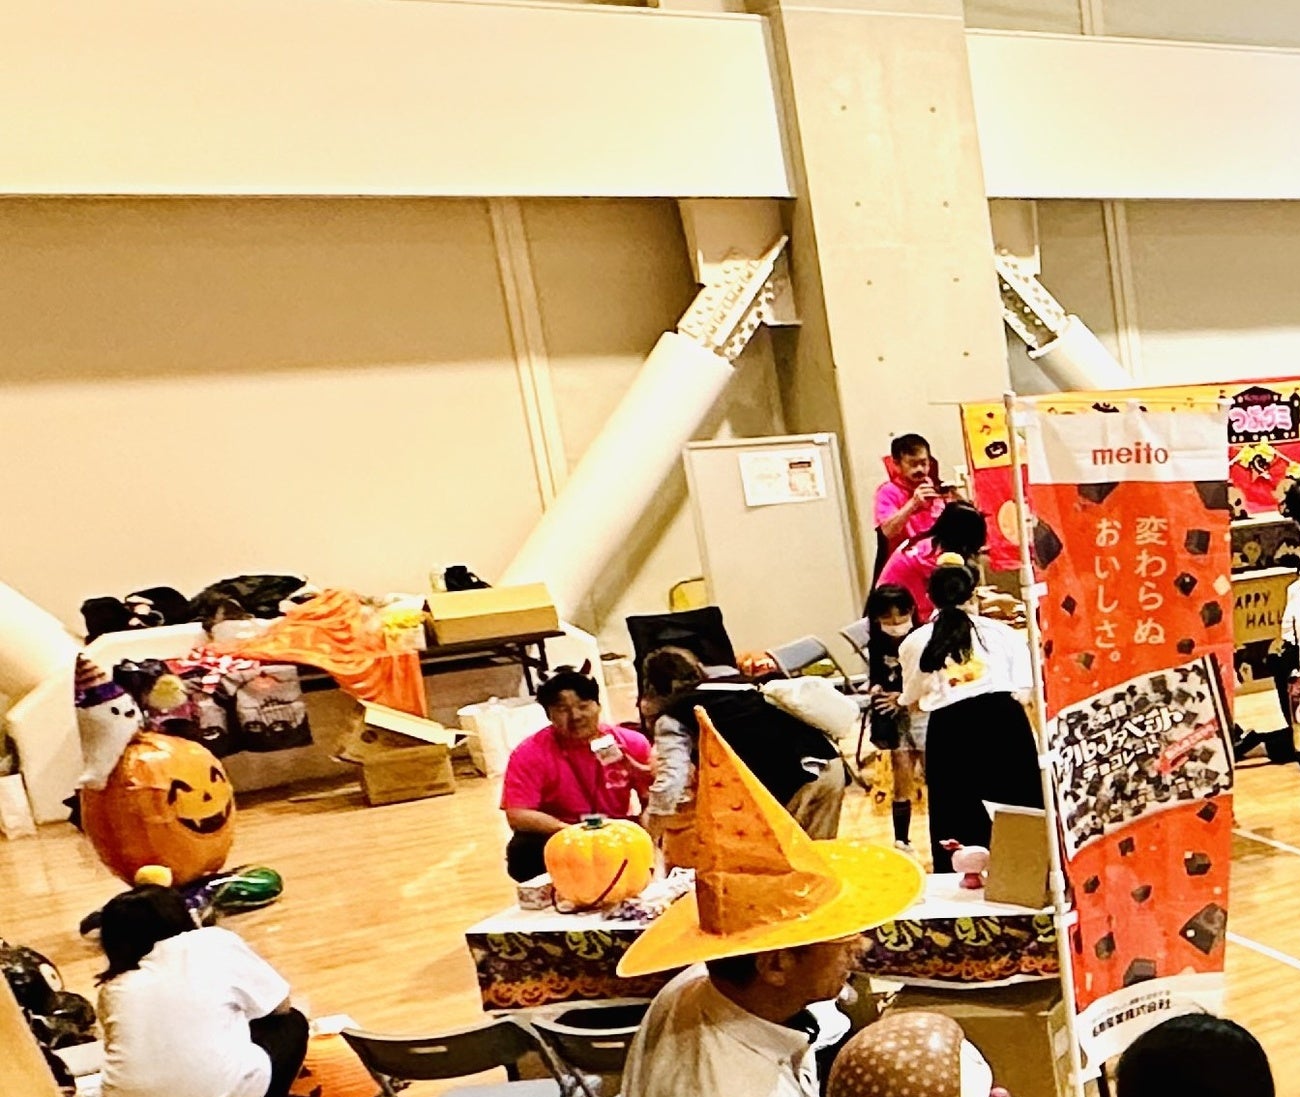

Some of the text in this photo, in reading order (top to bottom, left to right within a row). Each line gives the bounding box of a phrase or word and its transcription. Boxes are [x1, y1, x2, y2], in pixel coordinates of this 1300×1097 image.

[1092, 441, 1169, 466] meito
[1094, 517, 1123, 663] おいしさ。
[1133, 515, 1170, 646] 変わらぬ
[1234, 590, 1272, 610] APPY
